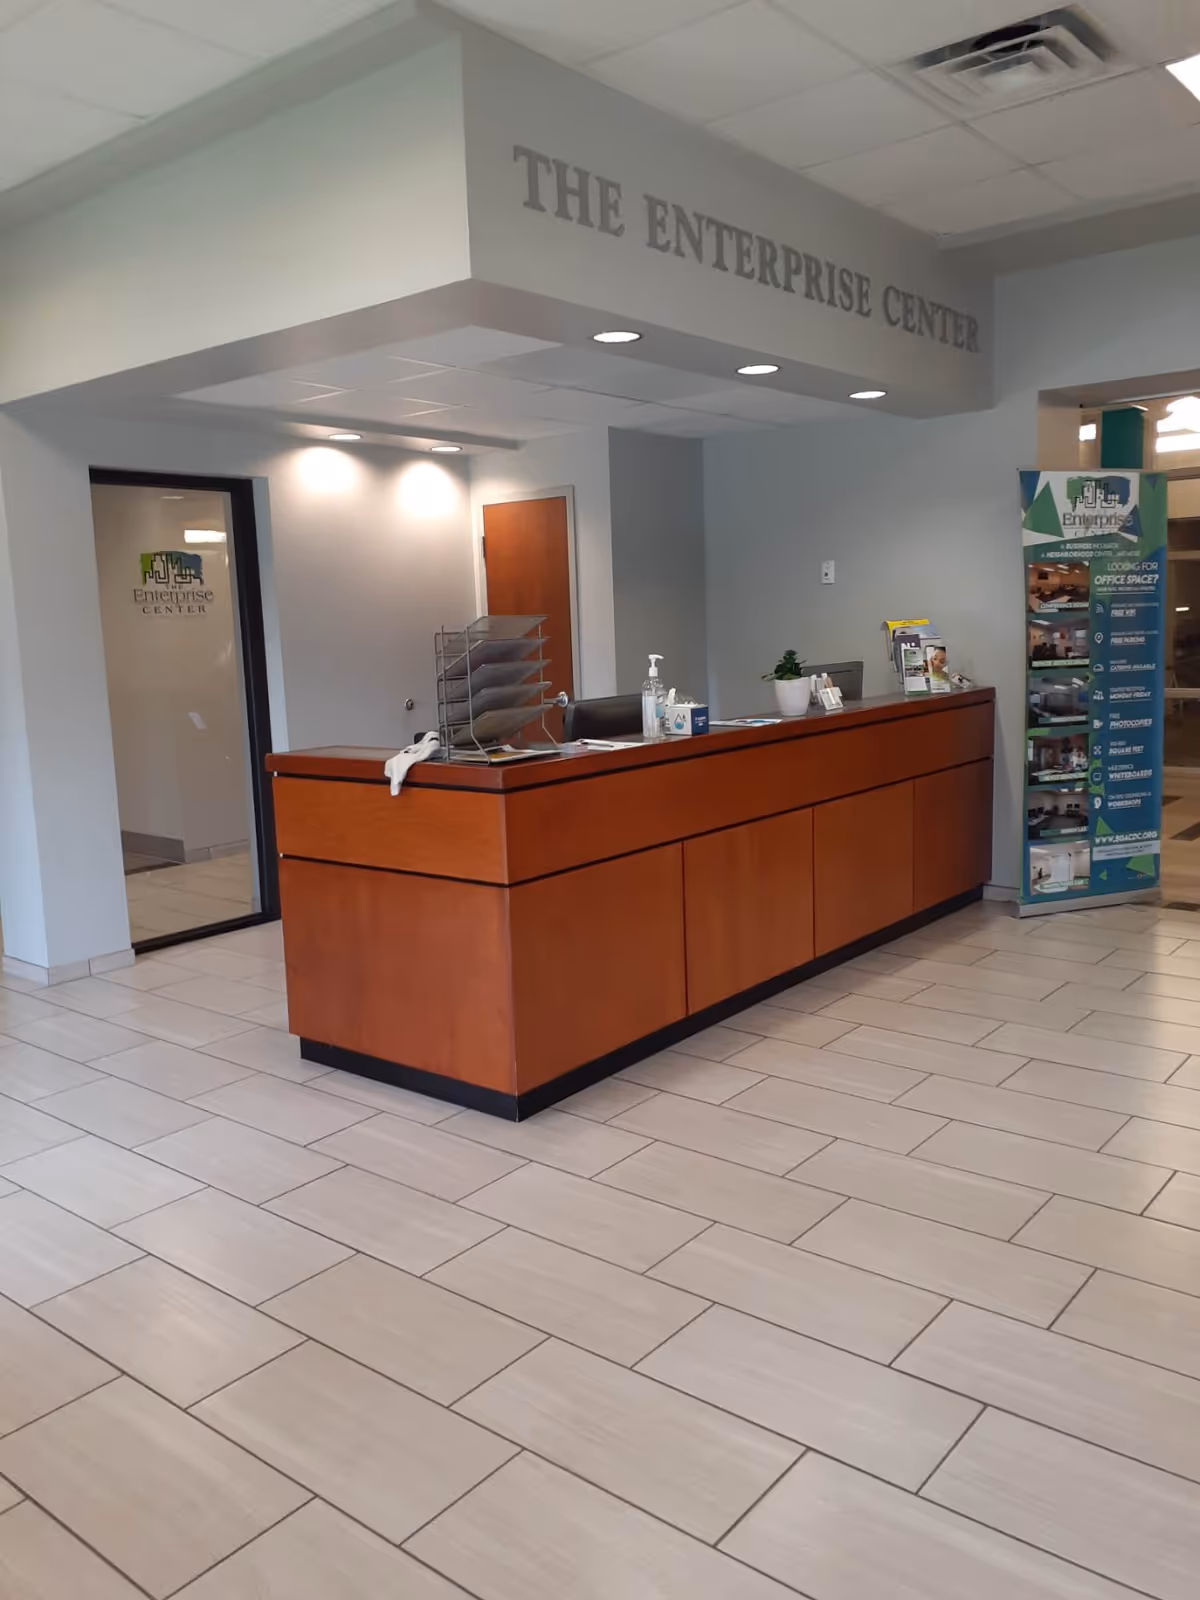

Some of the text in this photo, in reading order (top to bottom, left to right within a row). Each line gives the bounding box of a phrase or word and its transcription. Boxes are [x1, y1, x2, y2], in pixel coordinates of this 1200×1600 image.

[513, 145, 980, 353] THE ENTERPRISE CENTER
[1062, 513, 1134, 528] Enterprise
[1107, 562, 1159, 571] LOOKING FOR
[1094, 574, 1159, 585] OFFICE SPACE?
[133, 588, 214, 604] Enterprise
[142, 605, 206, 614] CENTER
[1109, 769, 1153, 779] WHITEBOARDS
